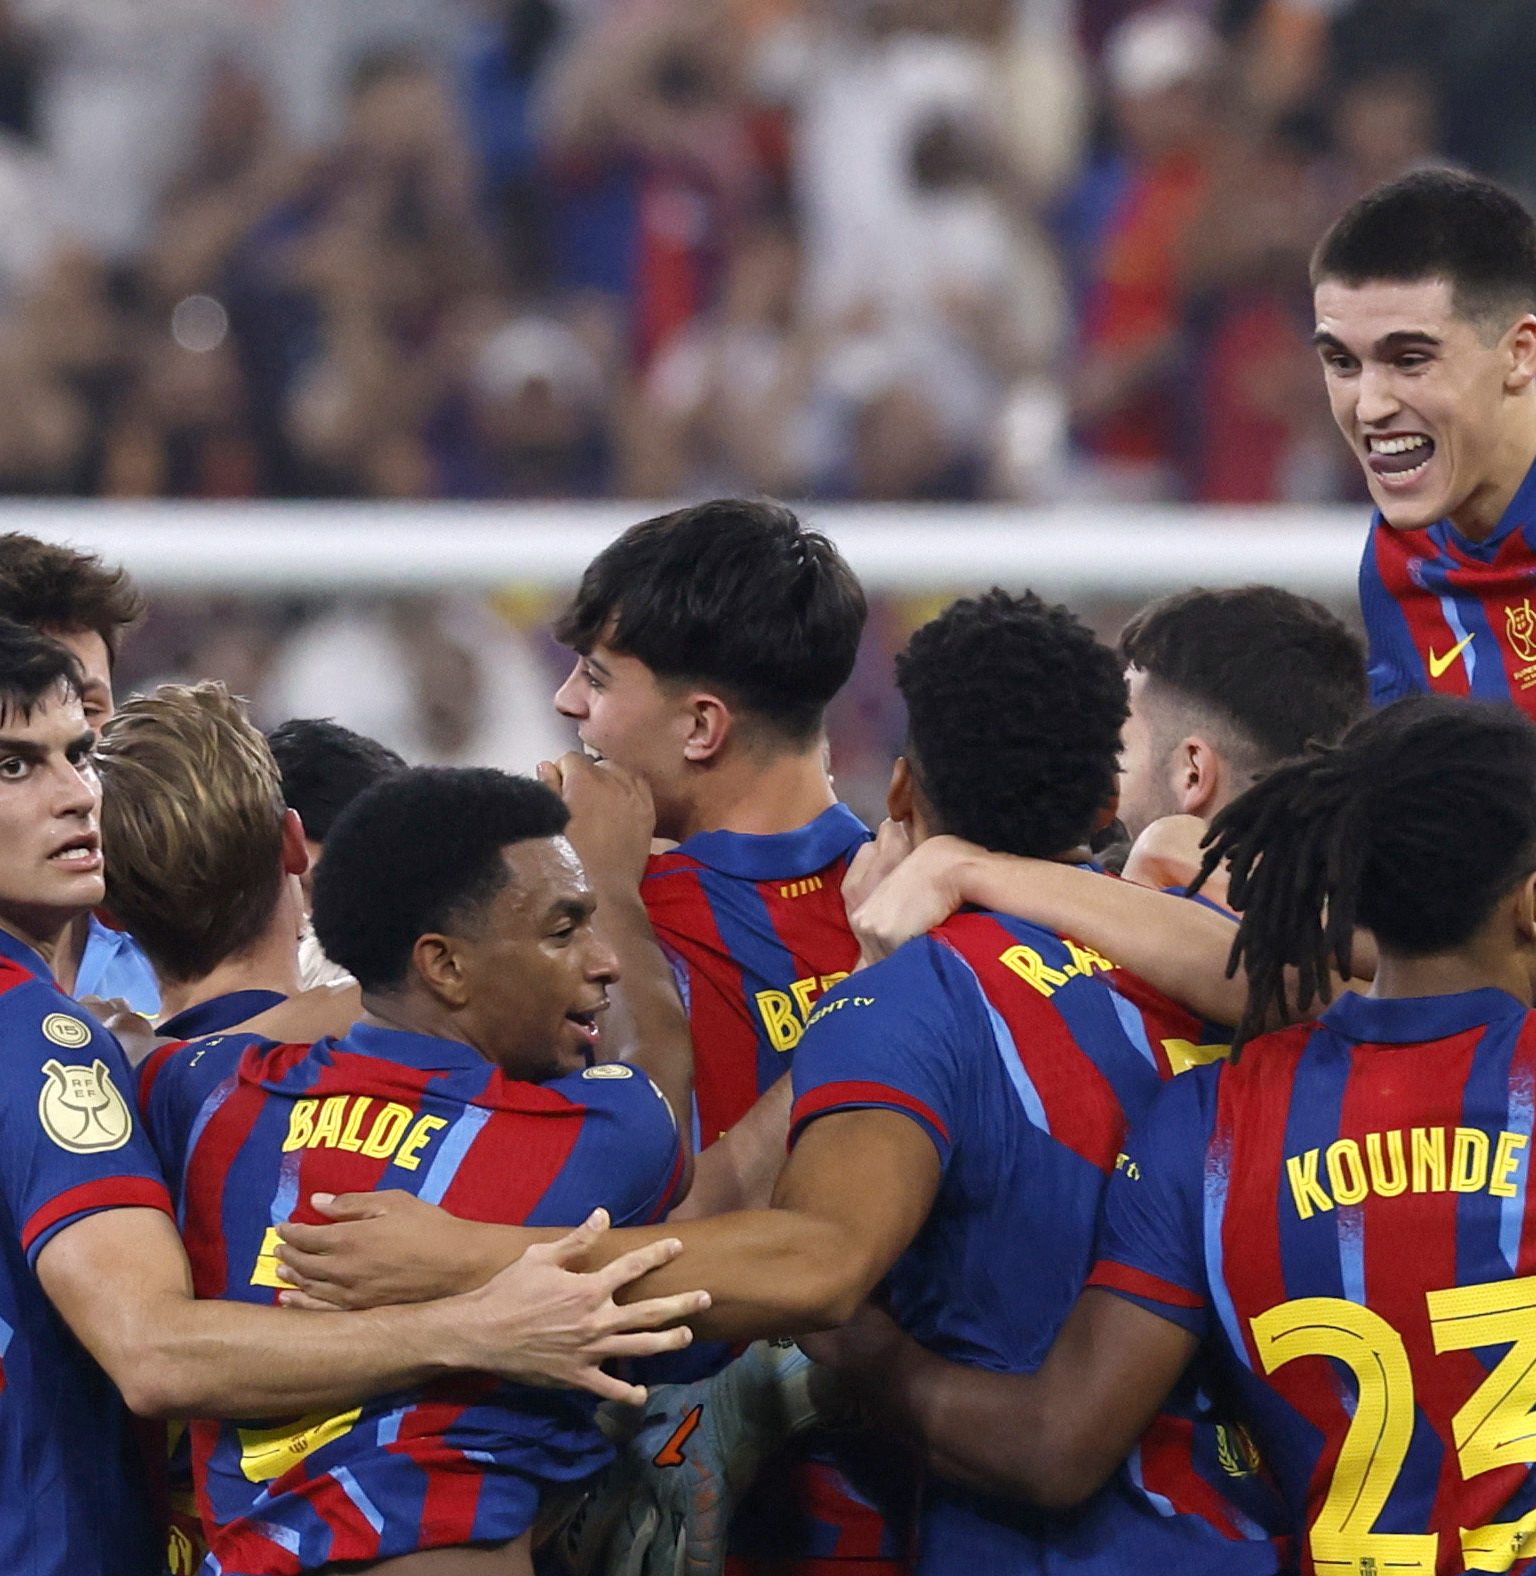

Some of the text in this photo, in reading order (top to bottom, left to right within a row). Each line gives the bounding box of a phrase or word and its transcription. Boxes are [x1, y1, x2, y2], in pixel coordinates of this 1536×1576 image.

[55, 1024, 80, 1036] 15
[281, 1096, 447, 1171] BALDE
[1286, 1126, 1528, 1220] KOUNDE
